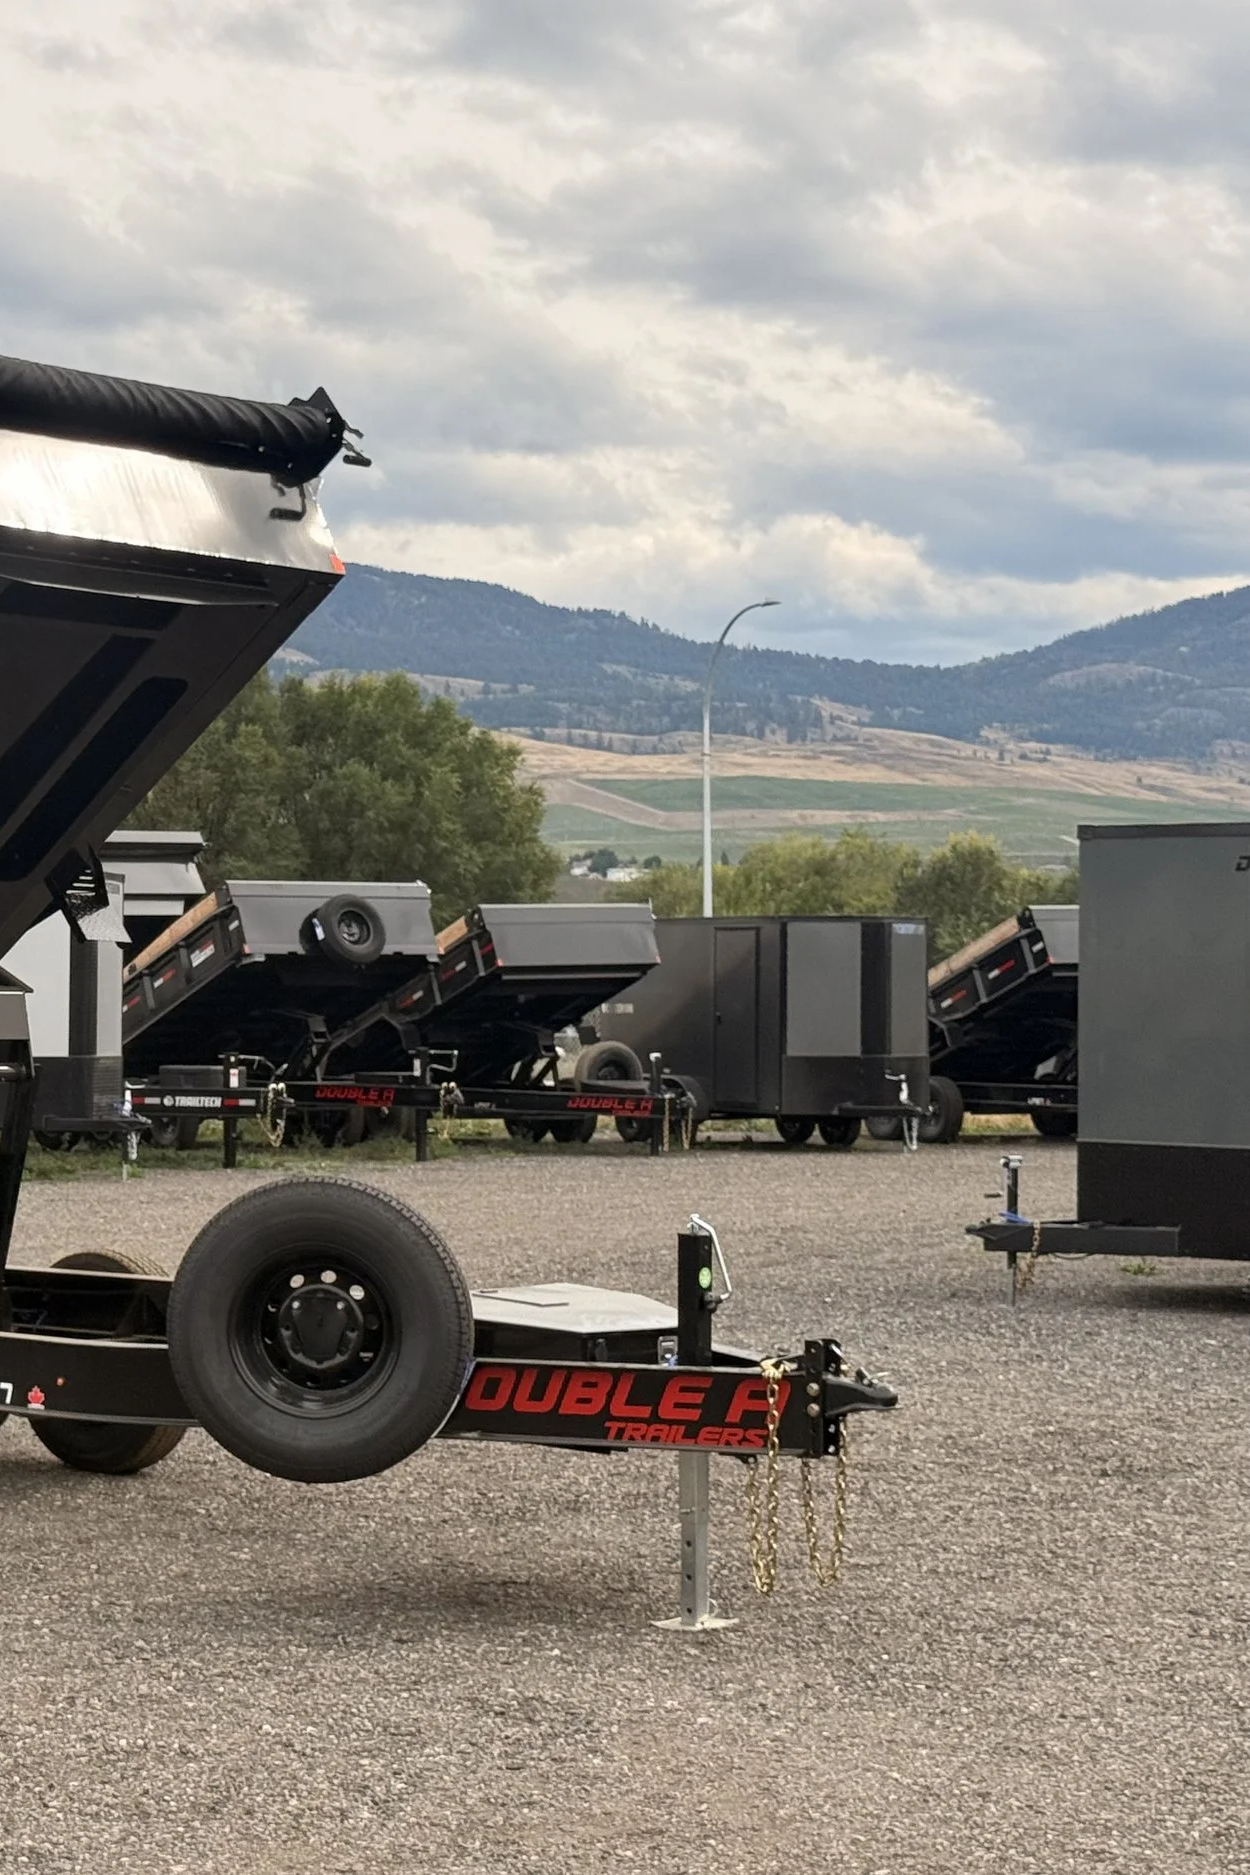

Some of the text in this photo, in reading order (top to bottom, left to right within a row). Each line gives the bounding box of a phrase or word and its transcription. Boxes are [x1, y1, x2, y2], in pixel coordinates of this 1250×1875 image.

[315, 1086, 379, 1099] DOUBLE
[174, 1096, 222, 1108] TRAILTECH
[566, 1096, 636, 1110] DOUBLE
[464, 1366, 792, 1424] OUBLE A
[604, 1420, 769, 1448] TRAILERS
